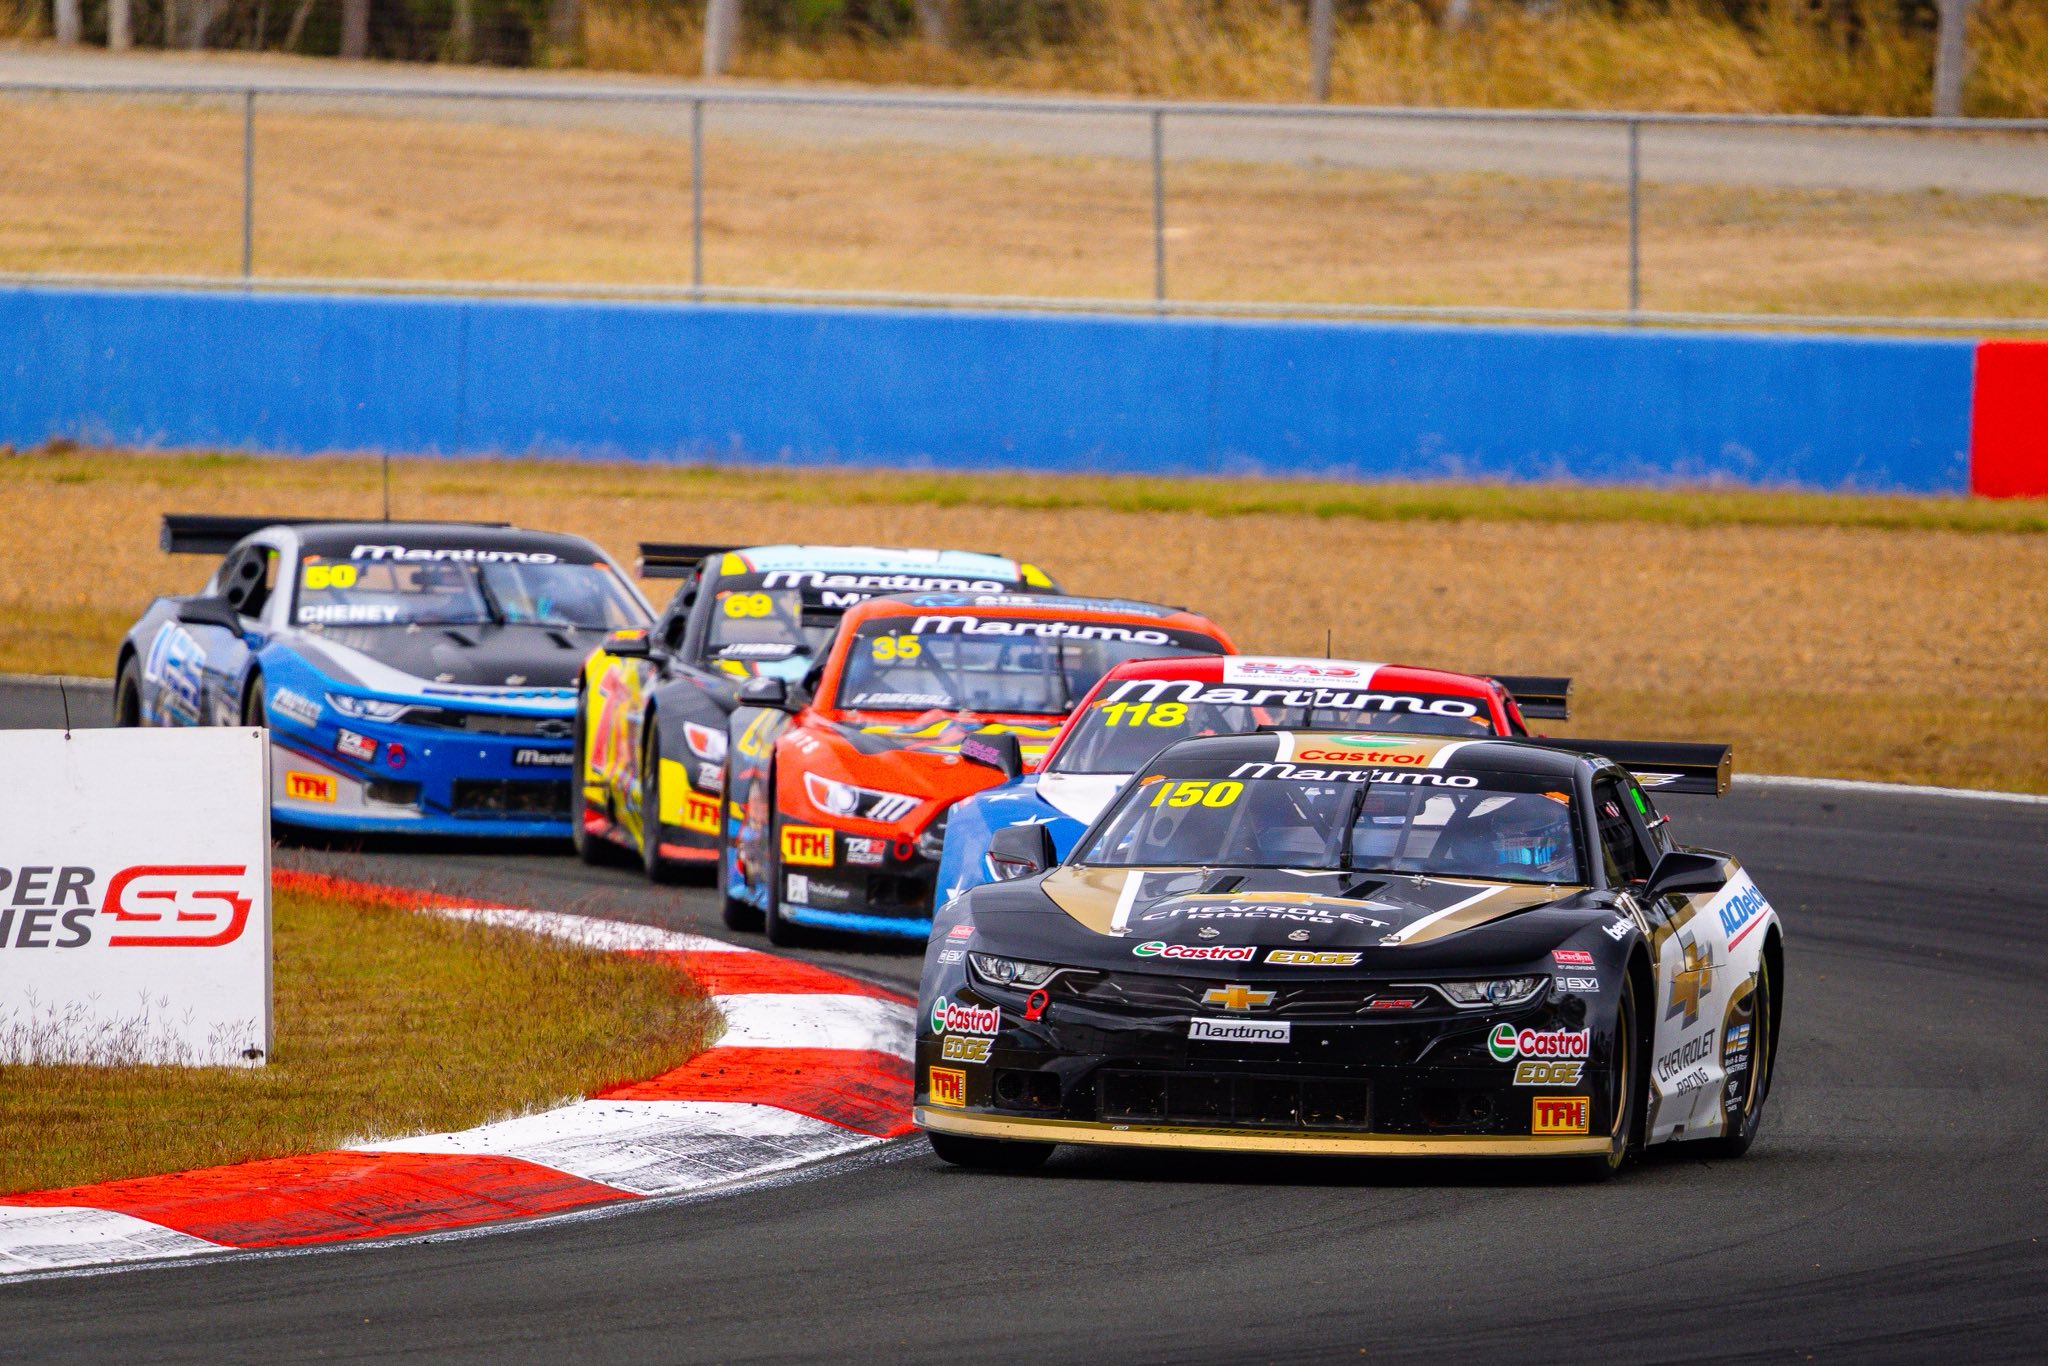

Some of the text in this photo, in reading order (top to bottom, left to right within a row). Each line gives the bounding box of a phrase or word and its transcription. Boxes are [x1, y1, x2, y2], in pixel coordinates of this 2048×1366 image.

[304, 564, 357, 590] 50
[299, 604, 400, 623] CHENEY
[723, 593, 773, 619] 69
[871, 634, 922, 661] 35
[1101, 702, 1189, 728] 118
[1299, 748, 1426, 766] Castrol
[292, 775, 328, 796] TFH
[1149, 781, 1244, 808] 150
[786, 832, 826, 857] TFH
[1142, 904, 1390, 928] CHEVROLET
[1188, 912, 1335, 925] RACING
[1163, 945, 1252, 962] Castrol
[1268, 950, 1360, 965] EDGE
[947, 1004, 999, 1034] Castrol
[943, 1037, 992, 1061] EDGE
[1519, 1027, 1589, 1056] Castrol
[1657, 1028, 1715, 1083] CHEVROLET
[931, 1070, 959, 1100] TFH
[1516, 1062, 1582, 1084] EDGE
[1676, 1067, 1709, 1098] RACING
[1537, 1102, 1582, 1127] TFH
